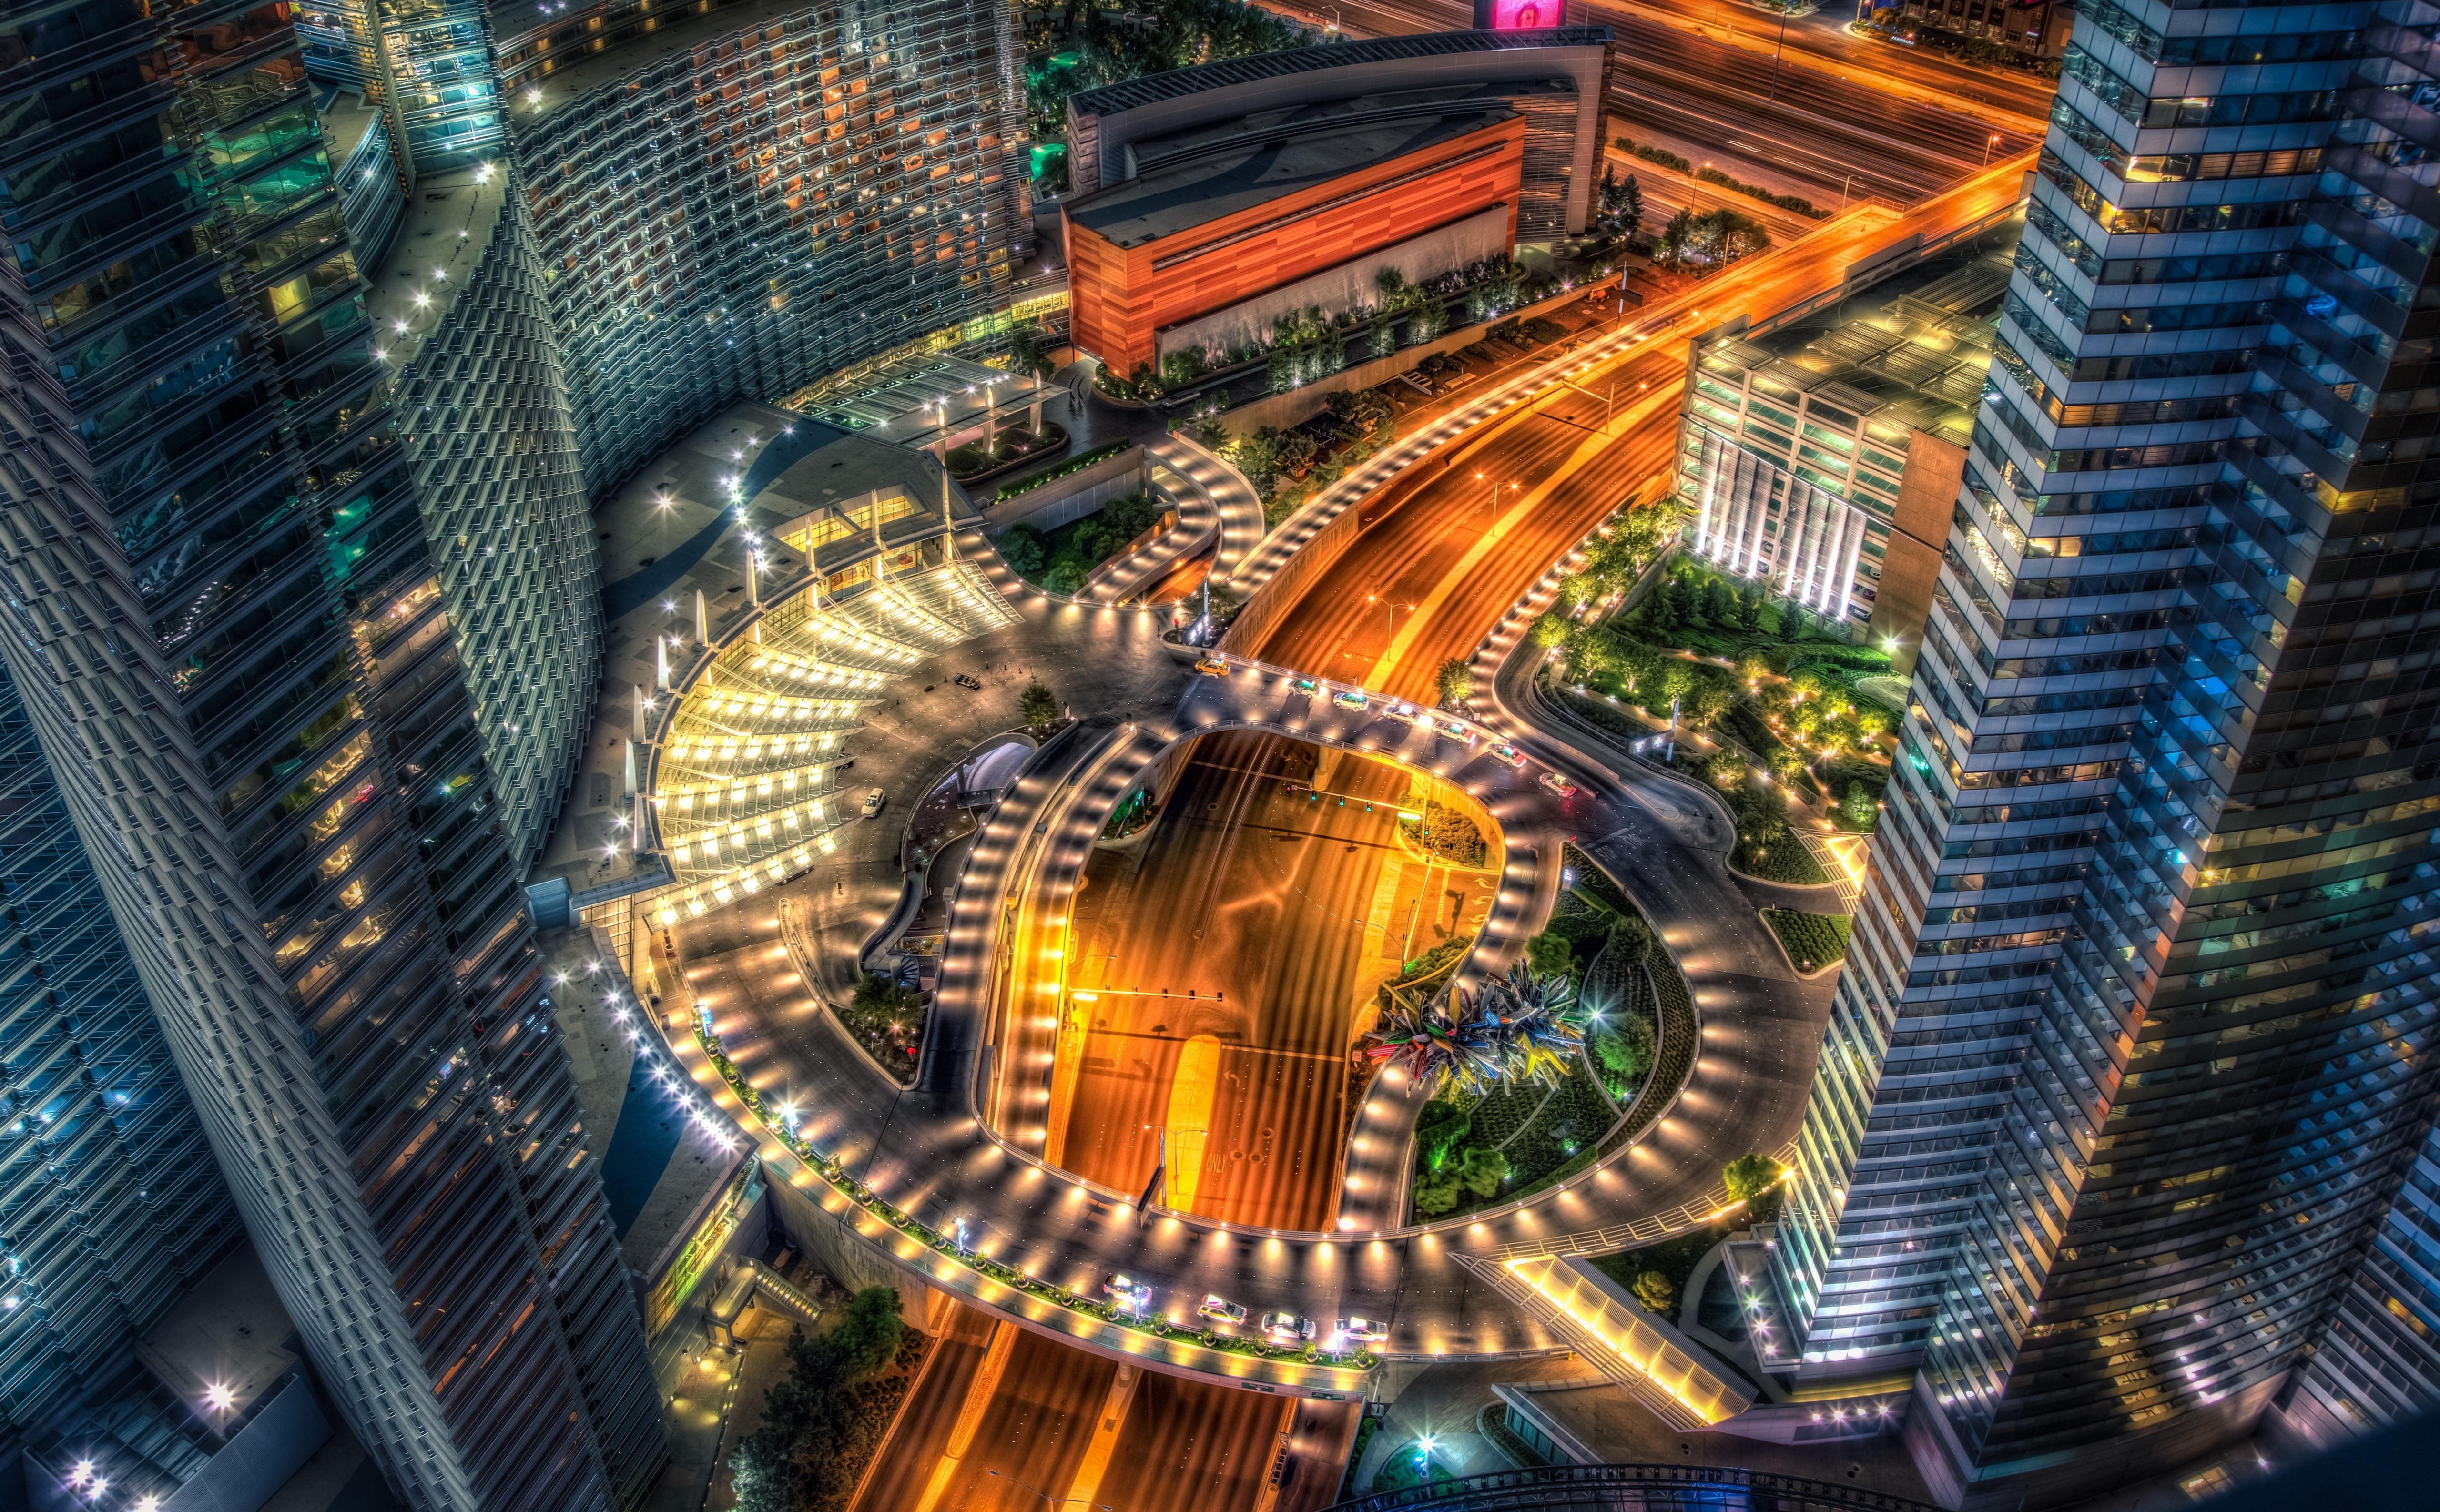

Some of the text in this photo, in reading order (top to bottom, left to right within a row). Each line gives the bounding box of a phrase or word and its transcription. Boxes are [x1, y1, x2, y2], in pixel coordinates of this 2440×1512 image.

[1891, 36, 1914, 45] PANORAMA
[1595, 845, 1617, 862] STOP
[1521, 870, 1538, 885] ONLY
[1206, 1153, 1228, 1174] ONLY
